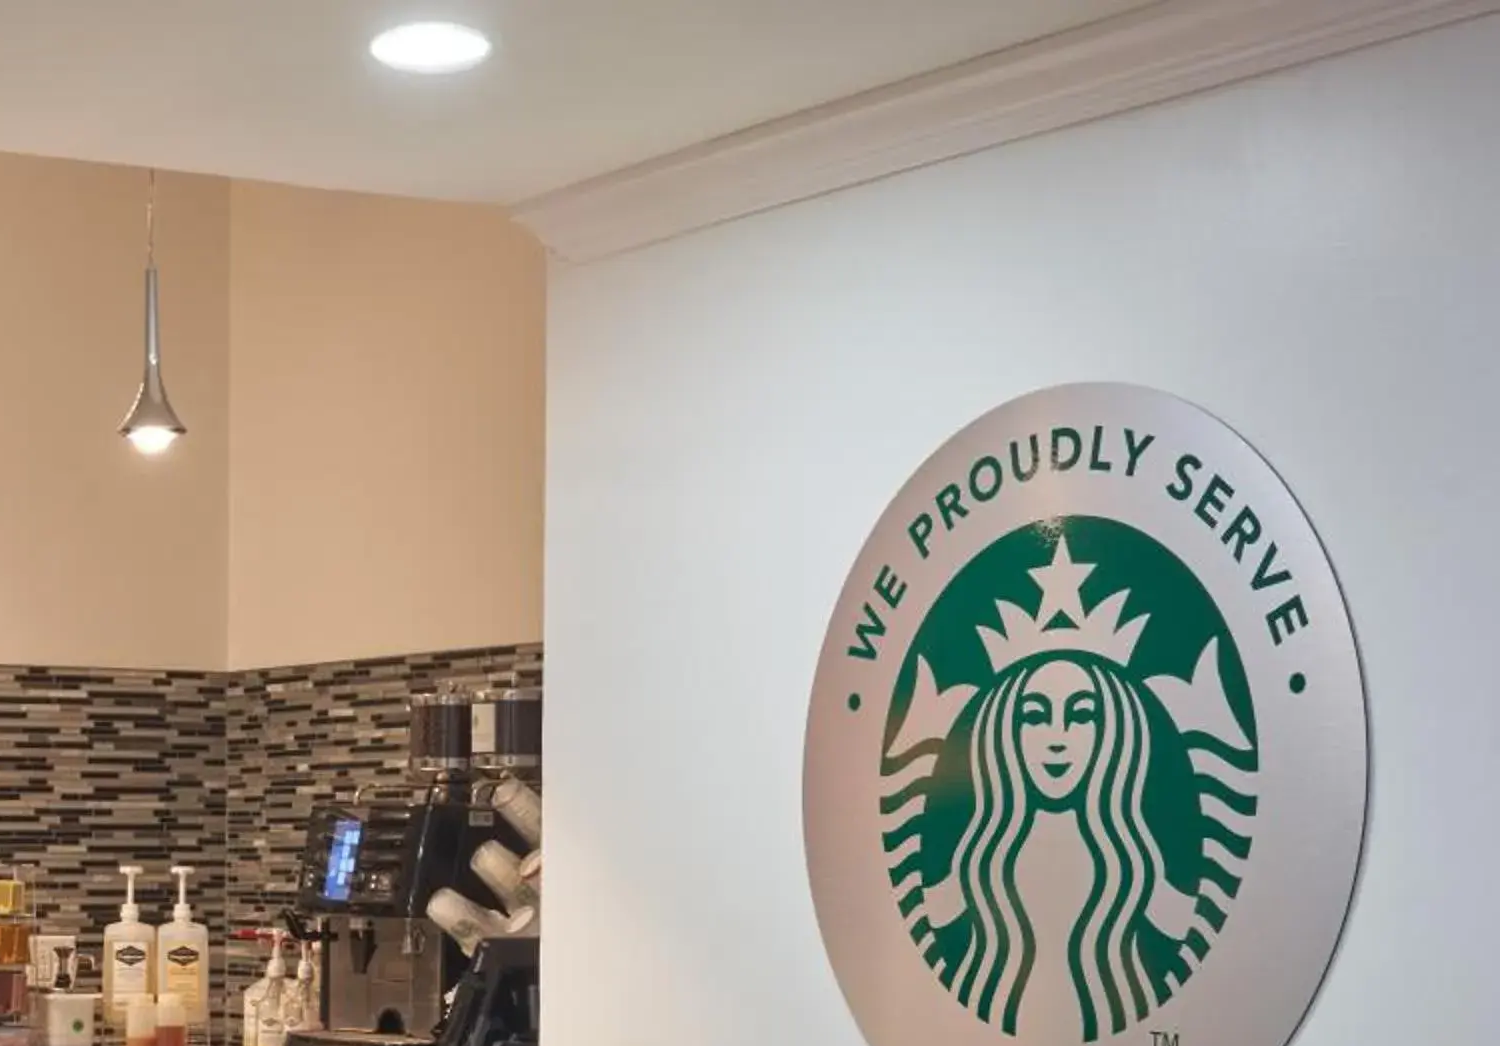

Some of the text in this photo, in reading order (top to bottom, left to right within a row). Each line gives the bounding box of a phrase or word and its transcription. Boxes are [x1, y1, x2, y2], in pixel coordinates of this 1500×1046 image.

[846, 425, 1310, 662] WE PROUDLY SERVE
